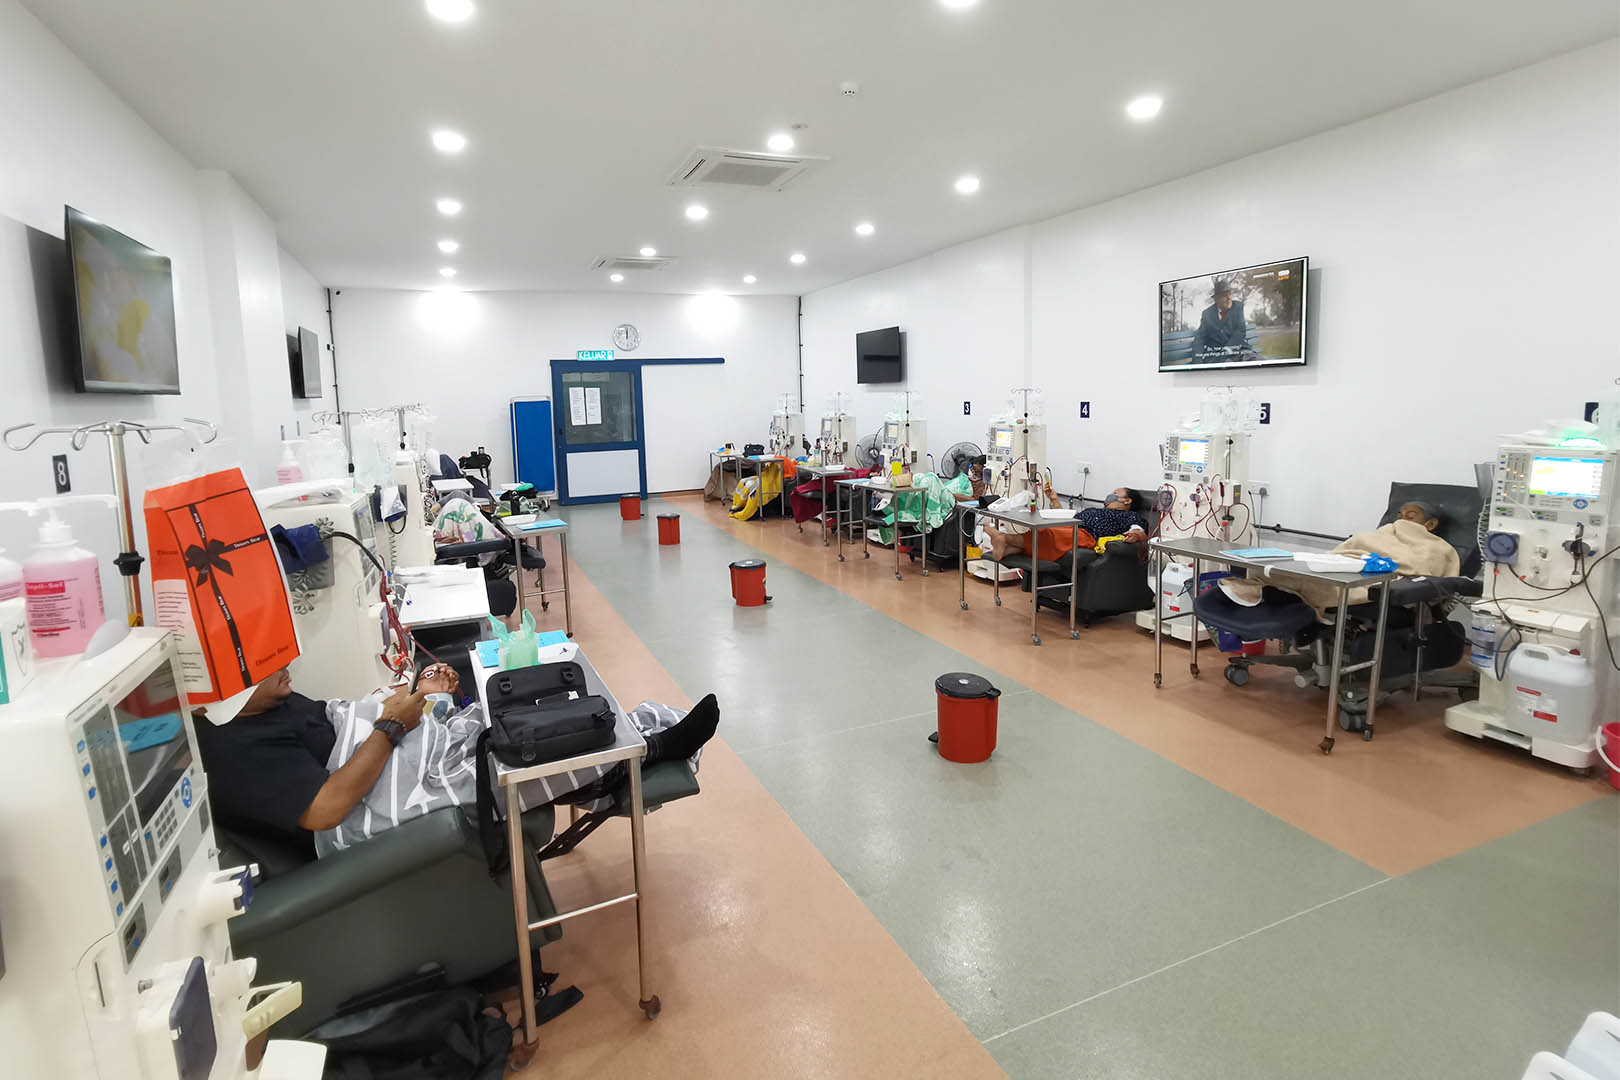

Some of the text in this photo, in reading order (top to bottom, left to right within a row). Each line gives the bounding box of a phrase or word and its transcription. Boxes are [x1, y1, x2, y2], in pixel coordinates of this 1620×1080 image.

[579, 351, 607, 360] KELUAR
[964, 403, 970, 413] 3
[1082, 404, 1089, 416] 4
[1259, 406, 1267, 420] 5
[57, 461, 67, 486] 8
